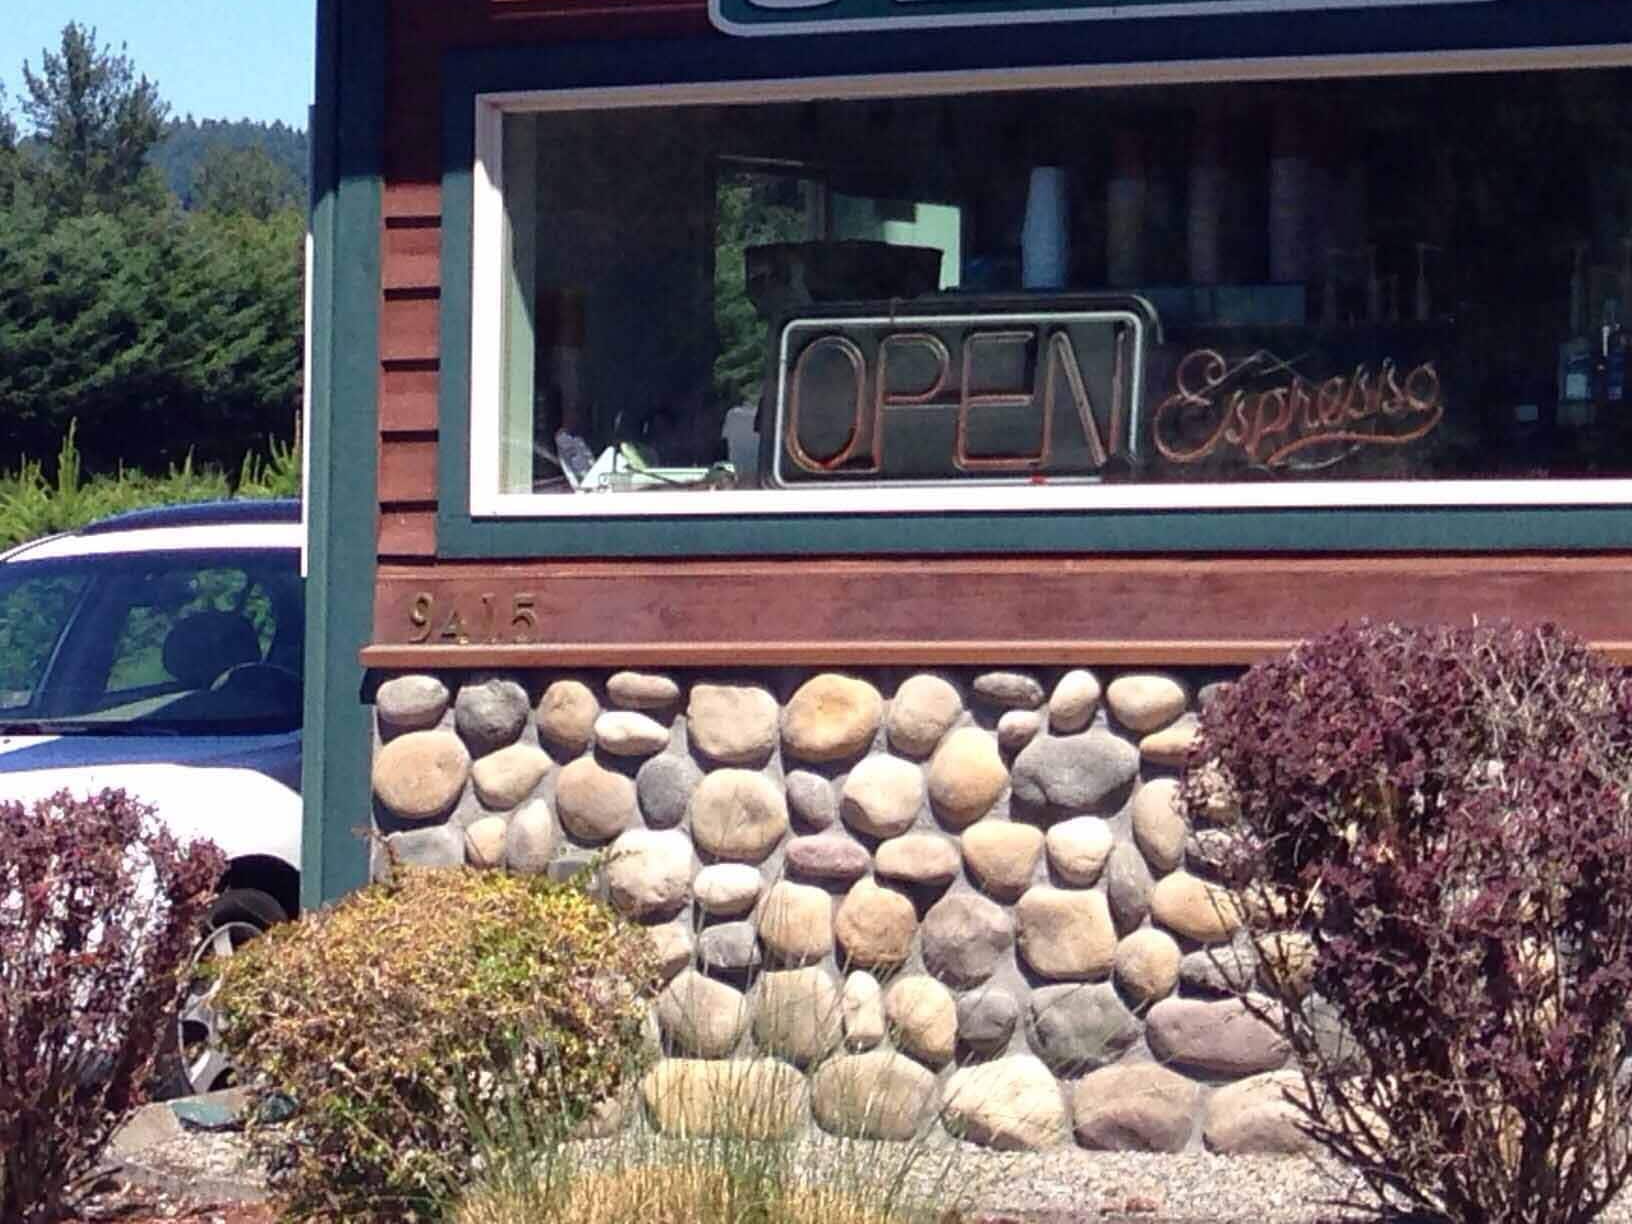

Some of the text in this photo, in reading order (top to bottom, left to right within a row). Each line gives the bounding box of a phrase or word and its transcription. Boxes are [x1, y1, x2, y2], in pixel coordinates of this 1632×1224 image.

[786, 329, 1128, 473] OPEN
[1152, 348, 1445, 470] Espresso
[408, 591, 537, 644] 9415
